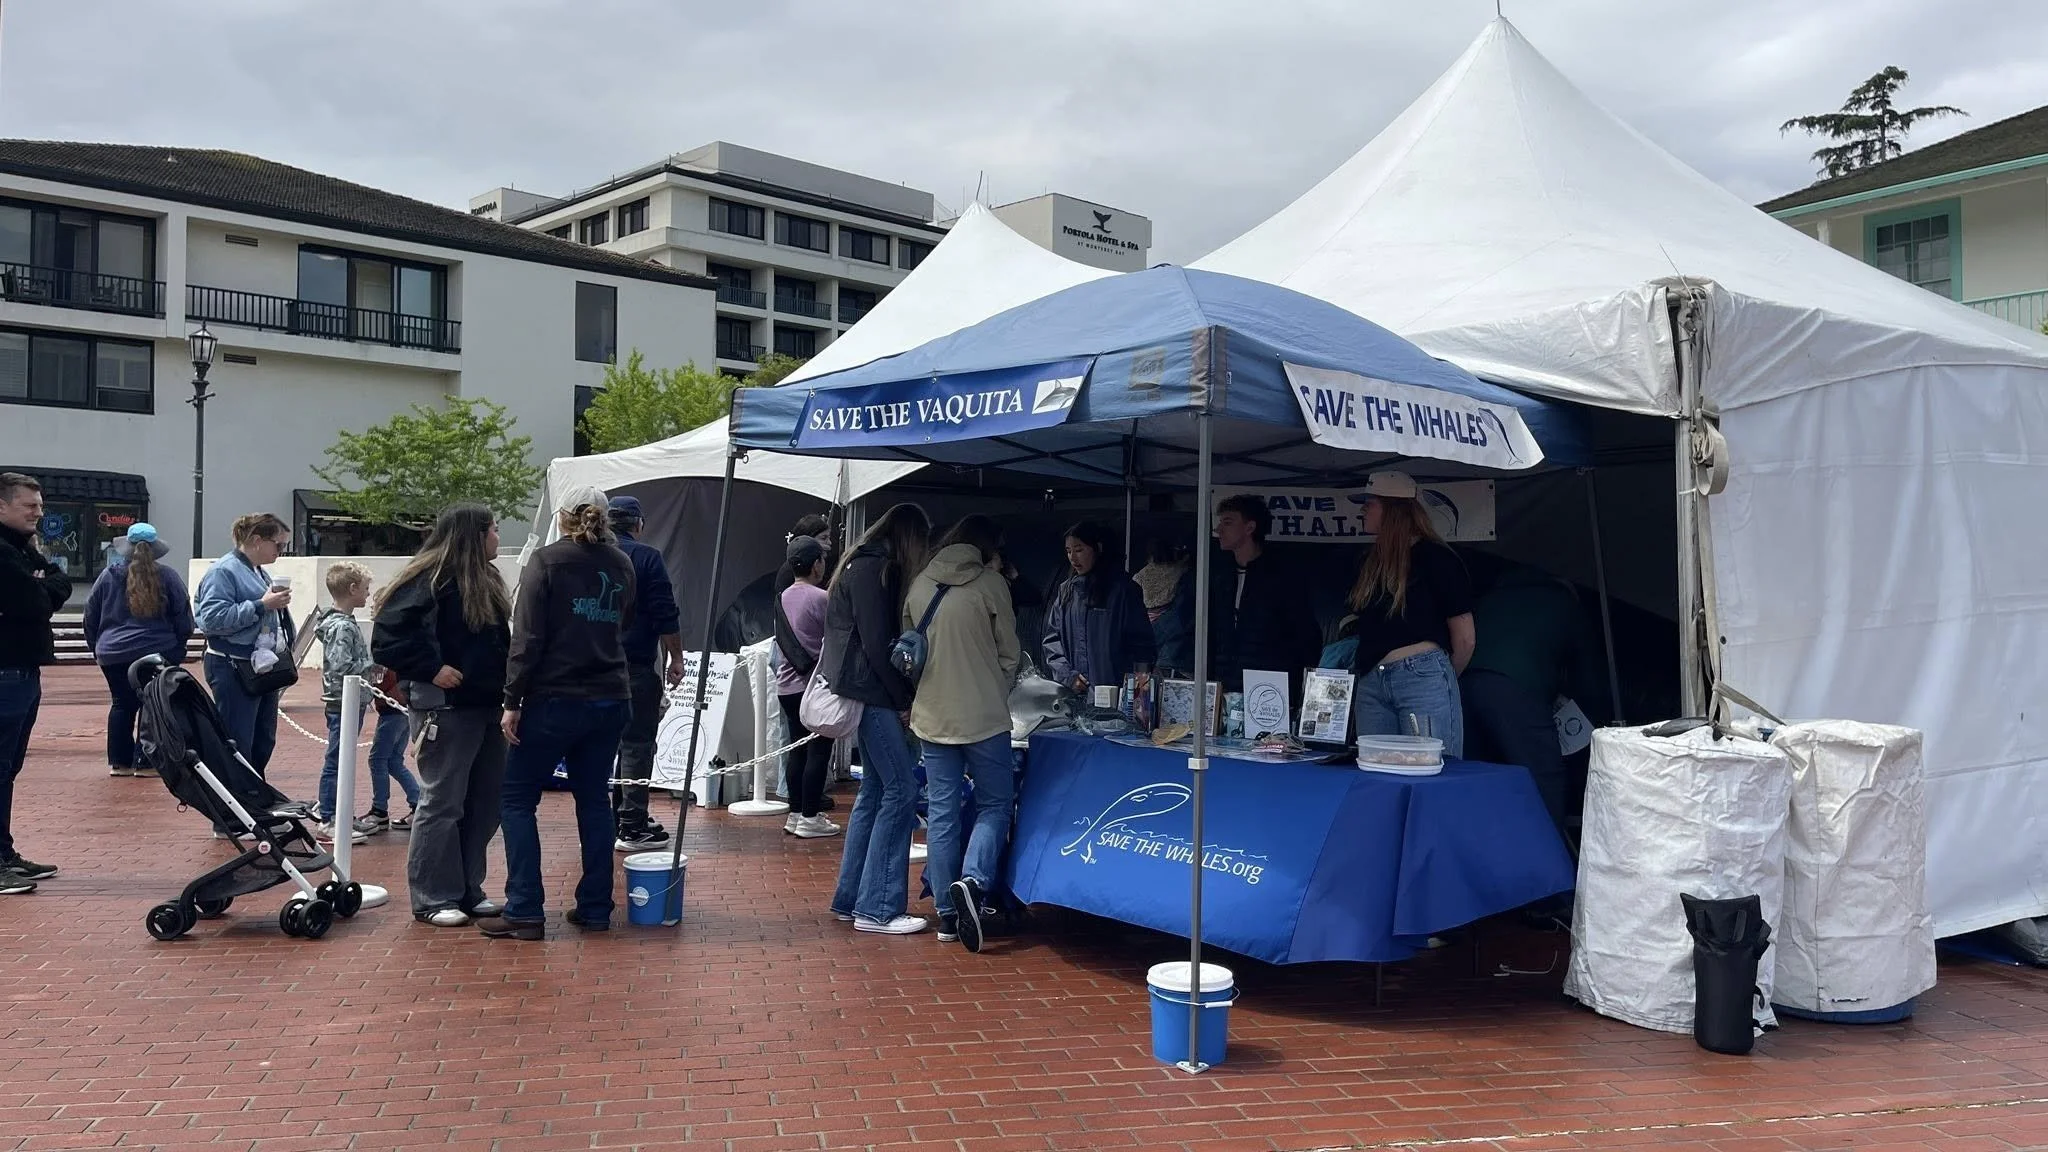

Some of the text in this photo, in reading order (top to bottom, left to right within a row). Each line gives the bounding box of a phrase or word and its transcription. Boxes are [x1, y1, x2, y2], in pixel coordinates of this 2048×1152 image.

[1063, 226, 1139, 250] PORTOLA HOTEL & SPA
[809, 388, 1023, 430] SAVE THE VAQUITA
[1361, 395, 1403, 434] THE
[1407, 402, 1488, 447] WHALES
[1265, 495, 1336, 512] AVE
[1270, 515, 1380, 537] HAL
[1096, 831, 1265, 885] SAVE THE WHLES.org
